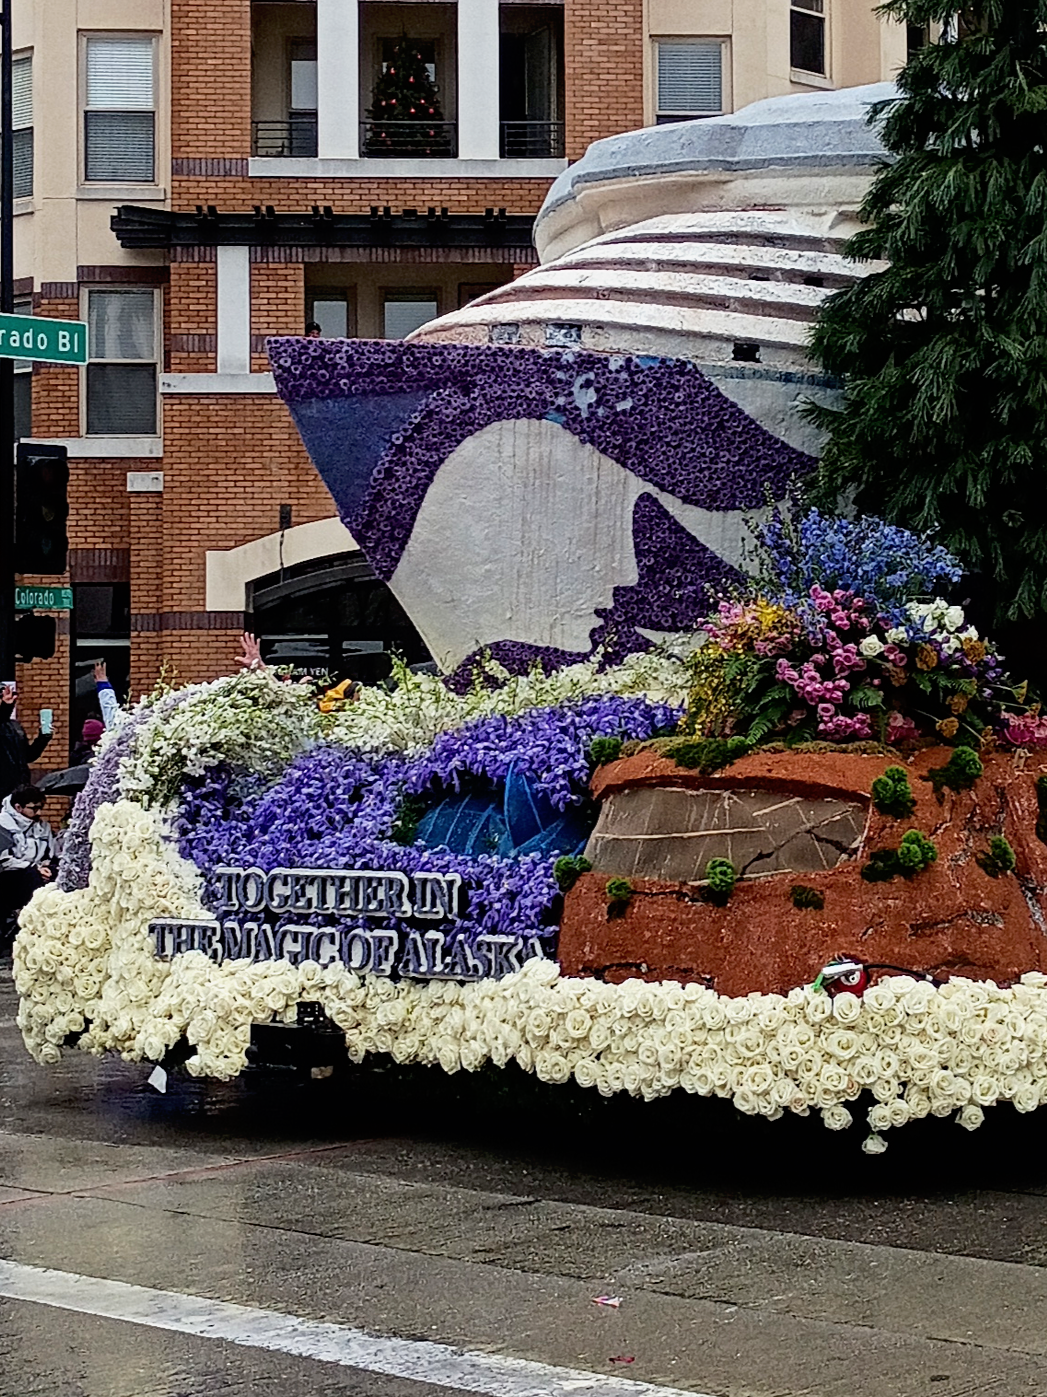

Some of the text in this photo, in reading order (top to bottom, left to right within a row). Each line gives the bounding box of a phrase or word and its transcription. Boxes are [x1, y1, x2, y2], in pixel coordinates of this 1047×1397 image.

[15, 587, 55, 605] Colorado
[215, 867, 462, 920] TOGETHER IN
[149, 917, 222, 966] THE
[223, 920, 341, 967] MAGIC
[340, 927, 399, 976] OF
